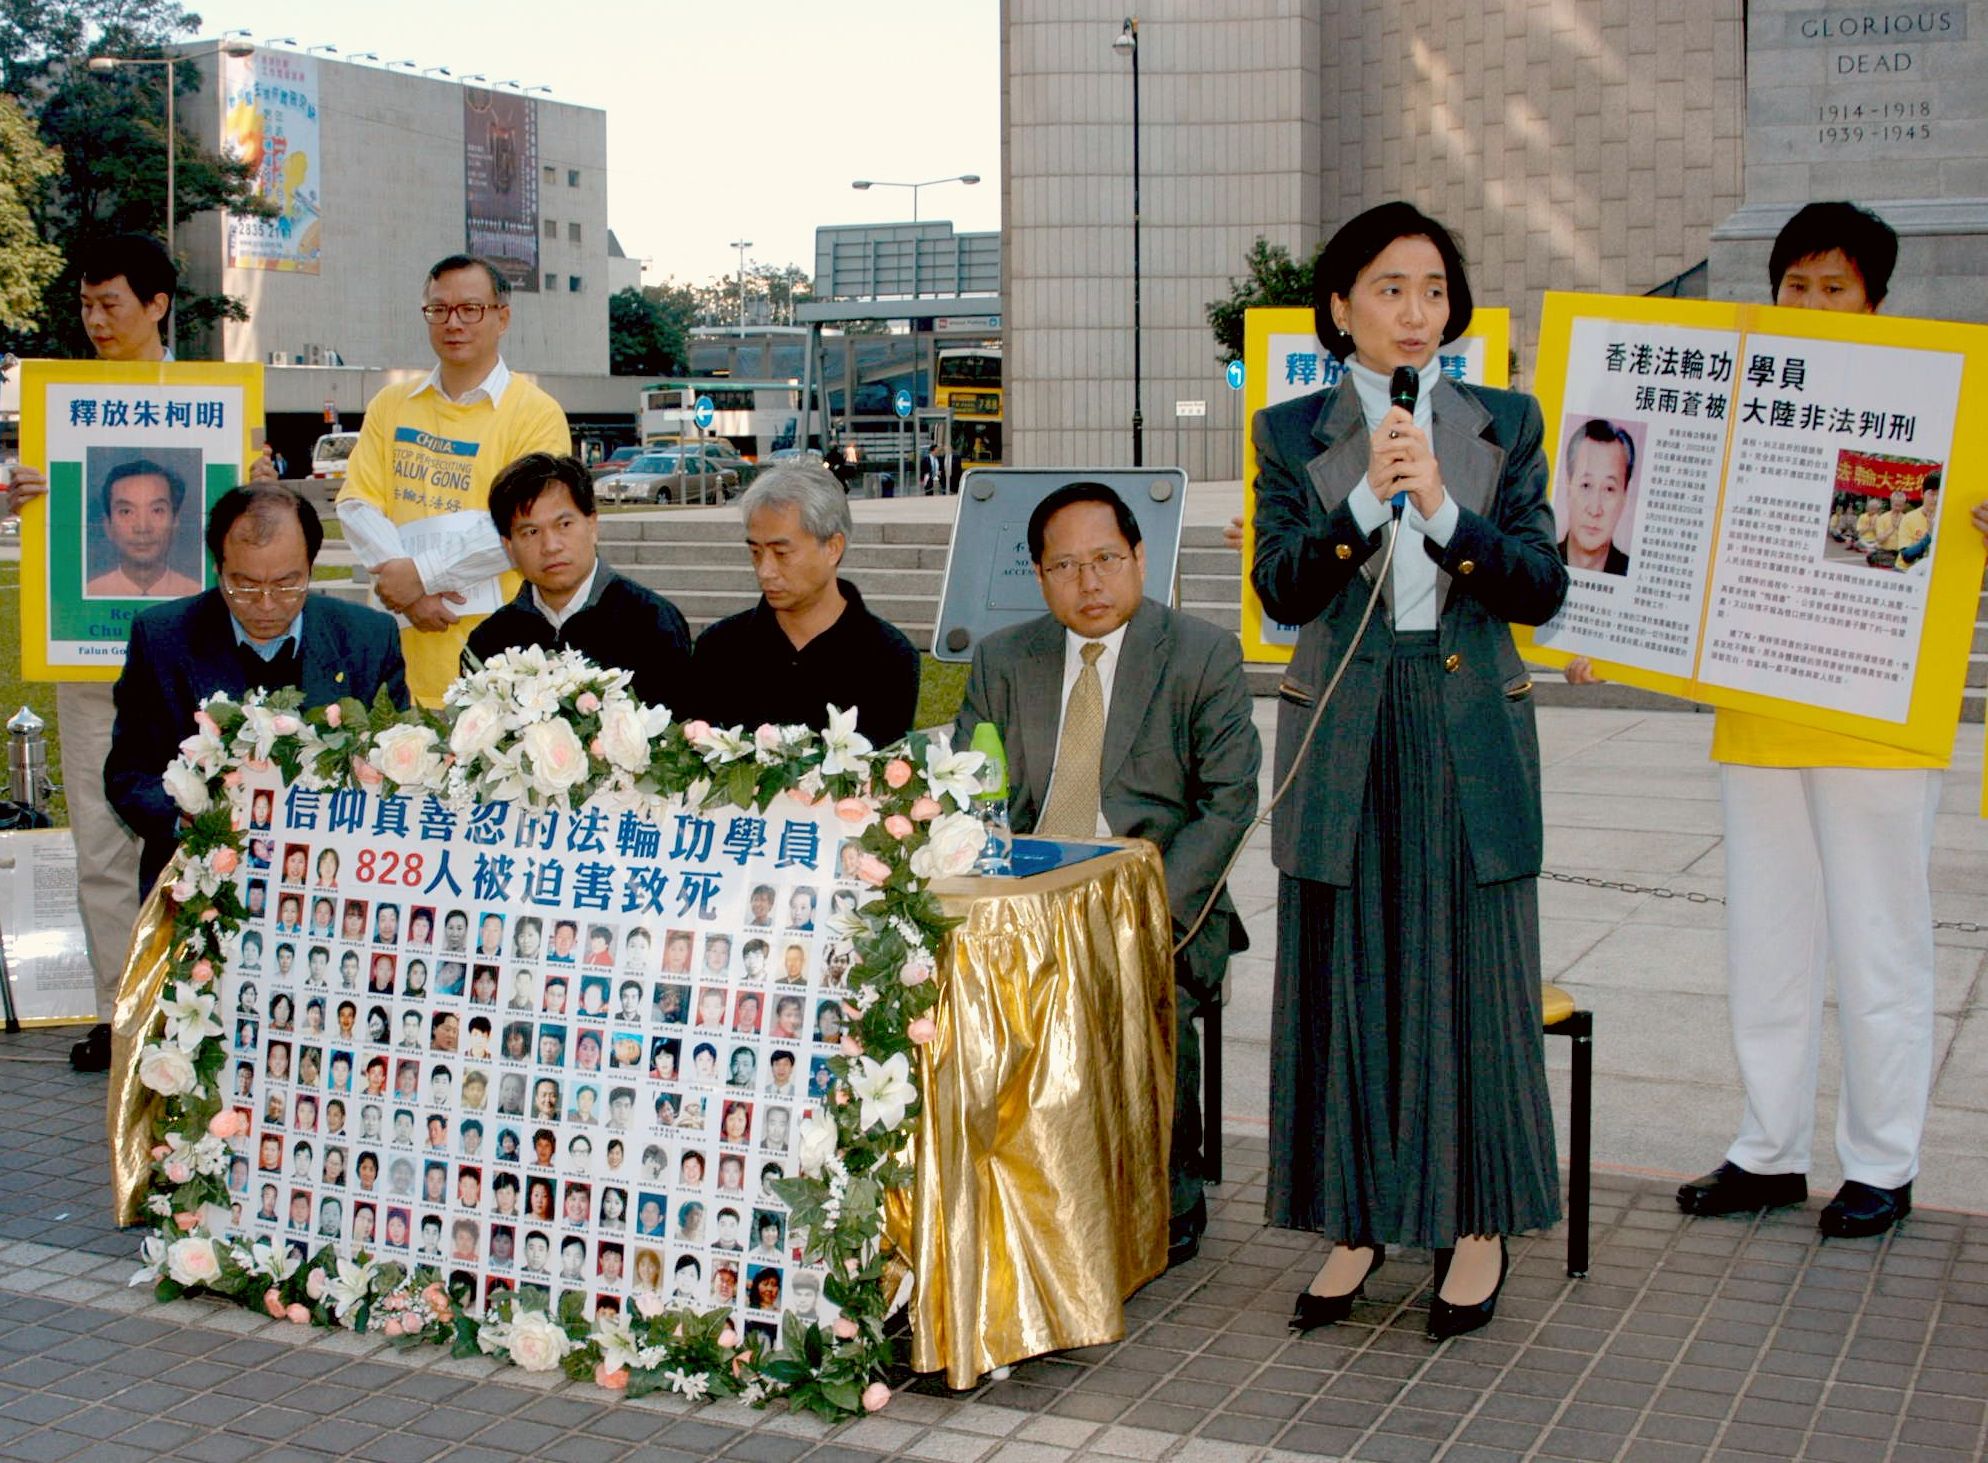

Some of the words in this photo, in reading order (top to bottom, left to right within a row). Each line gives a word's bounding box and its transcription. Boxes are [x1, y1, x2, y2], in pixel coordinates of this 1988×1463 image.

[1801, 12, 1951, 38] GLORIOUS
[1838, 52, 1912, 75] DEAD
[1606, 342, 1806, 391] 香港法輪功學員
[69, 398, 225, 429] 釋放朱柯明
[1635, 385, 1916, 442] 張雨蒼被大陸非法判刑
[393, 459, 429, 481] ALUN
[431, 470, 471, 492] GONG
[88, 624, 123, 637] Chu
[78, 646, 108, 655] Falun
[111, 646, 128, 655] Go
[284, 784, 822, 871] 信仰真善忍的法輪功學員
[355, 848, 724, 921] 828人被迫害致死
